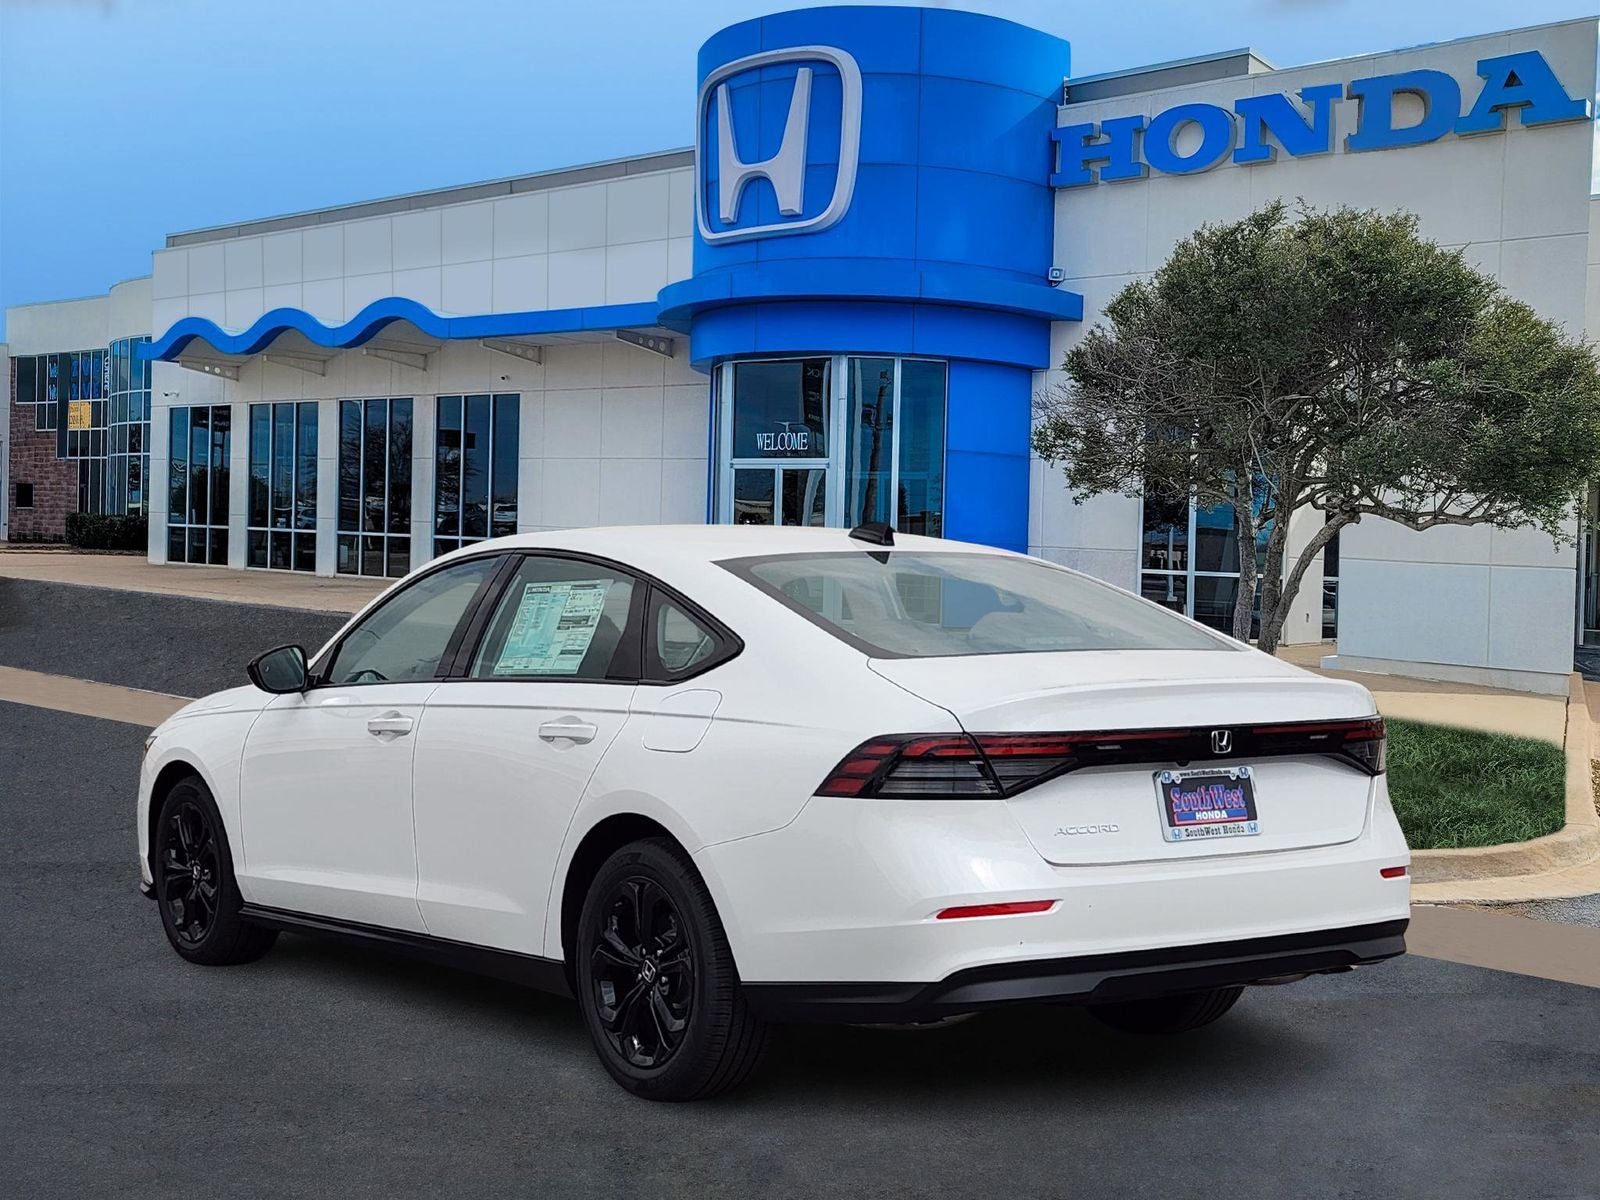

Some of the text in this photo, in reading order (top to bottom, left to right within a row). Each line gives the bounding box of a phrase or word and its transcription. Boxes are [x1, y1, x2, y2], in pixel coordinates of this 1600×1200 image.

[1050, 50, 1592, 189] HONDA
[756, 432, 809, 451] WELCOME
[1170, 784, 1247, 812] SouthWest
[1195, 810, 1229, 821] HONDA
[1053, 824, 1120, 837] ACCORD
[1184, 824, 1246, 838] SouthWest Honda
